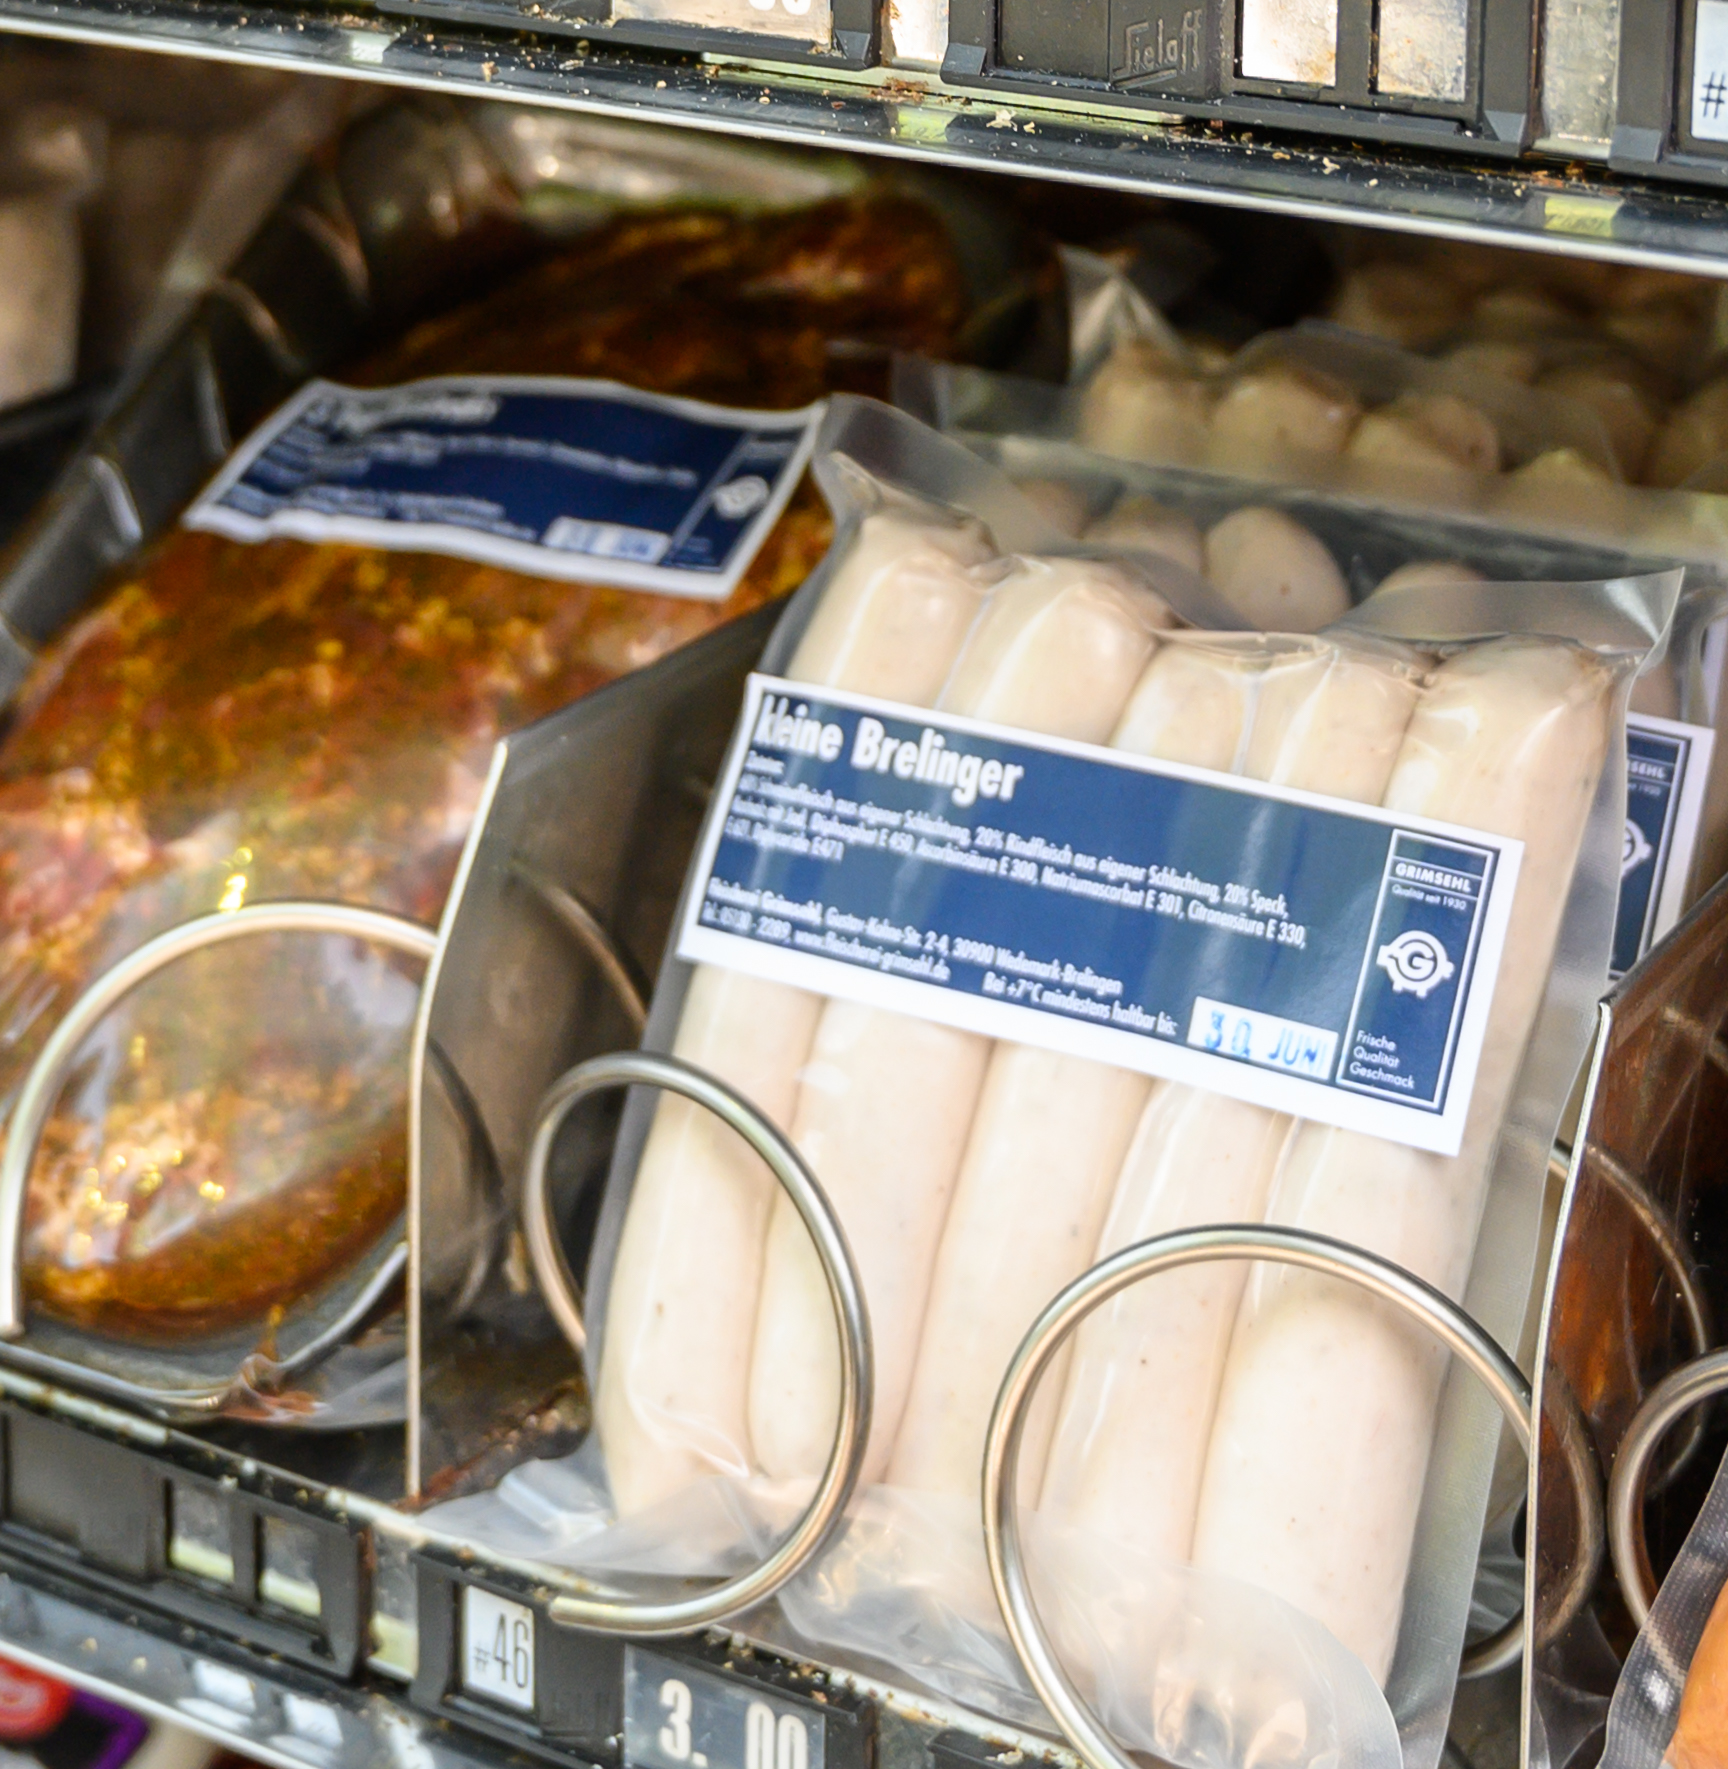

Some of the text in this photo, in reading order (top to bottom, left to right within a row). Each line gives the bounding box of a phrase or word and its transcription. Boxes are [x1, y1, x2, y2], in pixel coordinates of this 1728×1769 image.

[850, 716, 1025, 806] Brelinger
[1394, 862, 1472, 893] GRIMSEHL
[1391, 883, 1425, 900] Qualität
[1442, 894, 1467, 911] 1930
[1356, 1030, 1397, 1051] Frische
[1353, 1046, 1400, 1069] Qualität
[1349, 1061, 1415, 1090] Geschmack
[473, 1612, 530, 1689] #46
